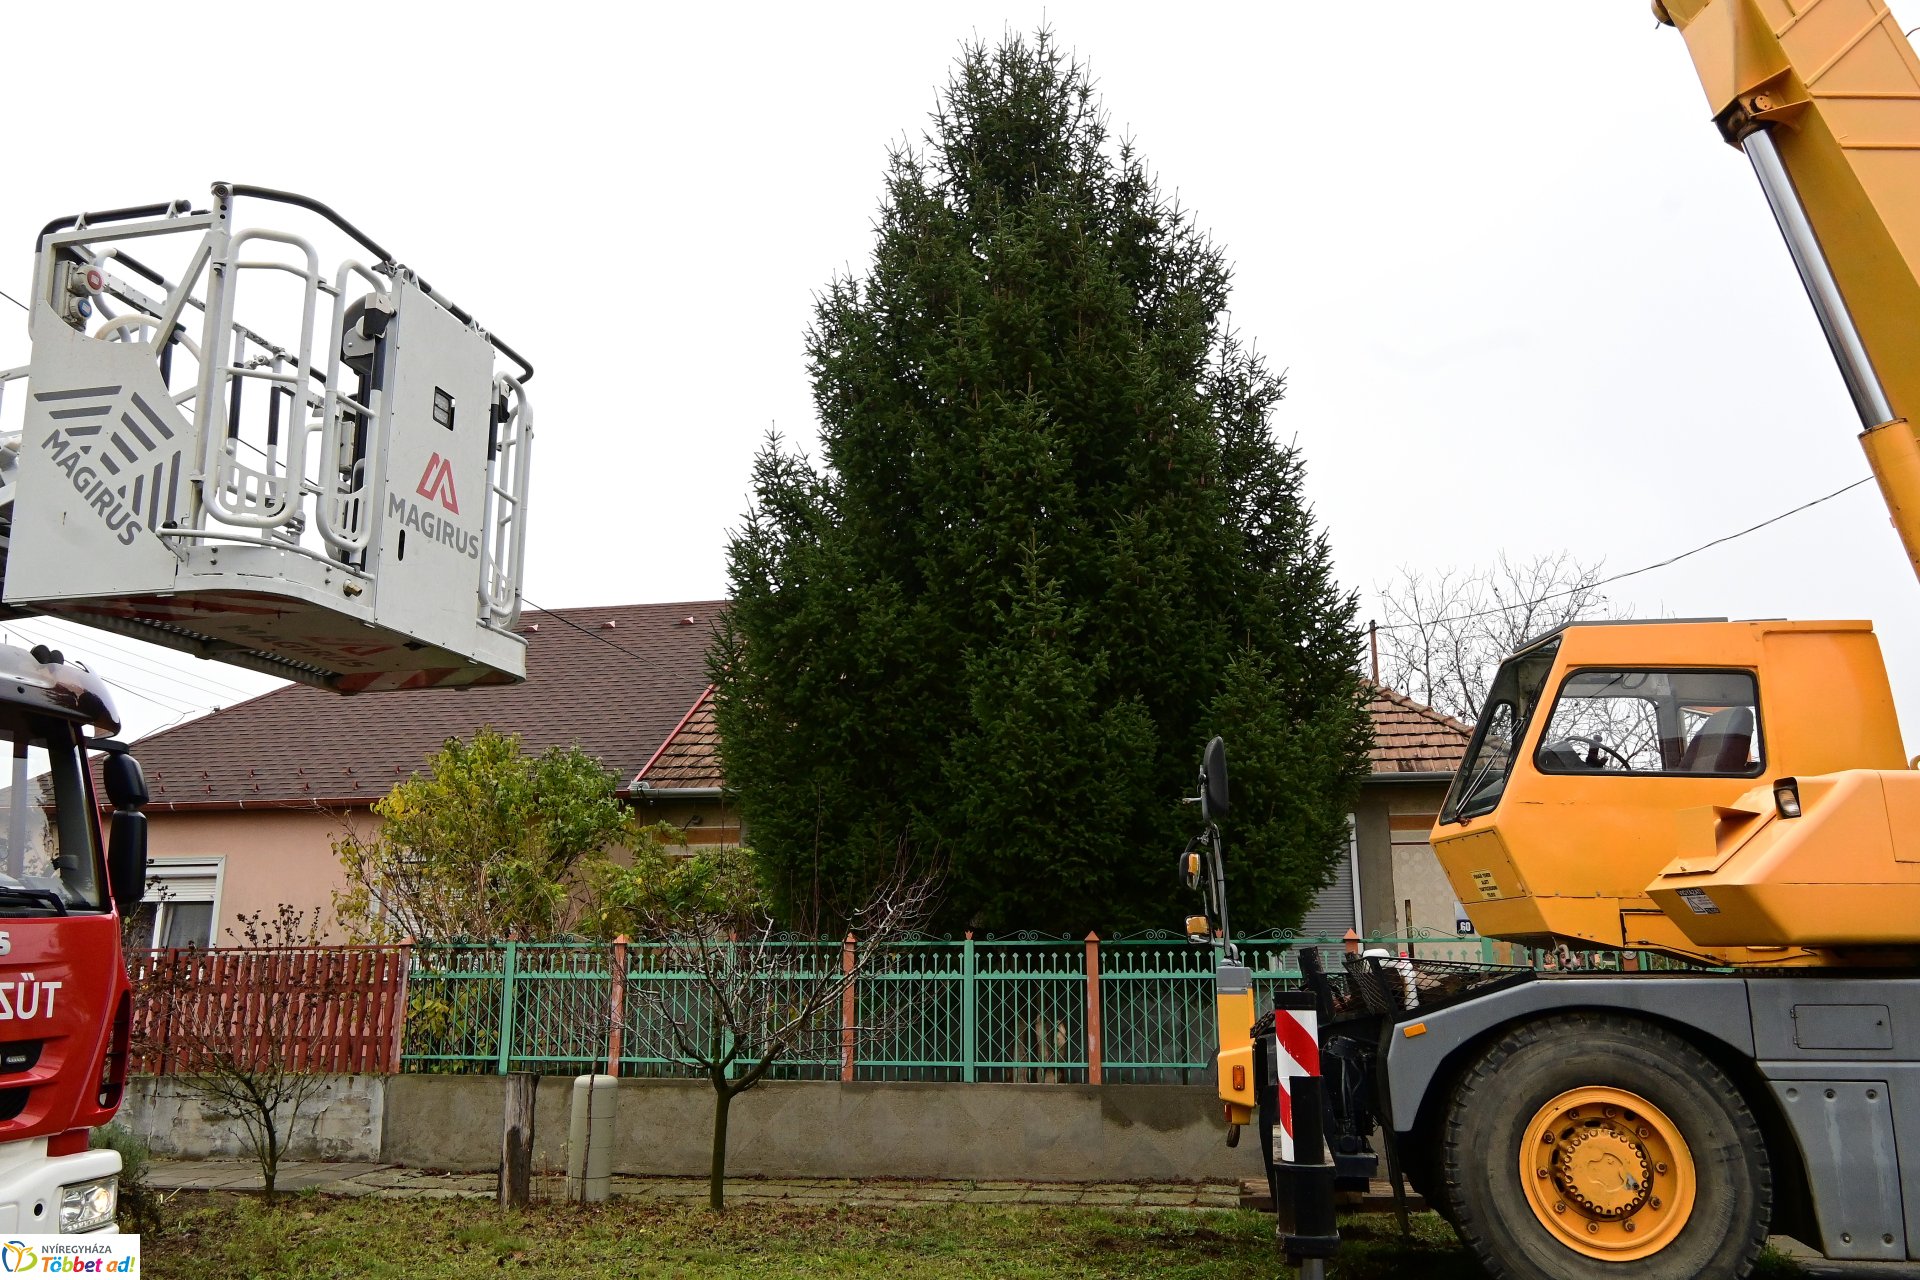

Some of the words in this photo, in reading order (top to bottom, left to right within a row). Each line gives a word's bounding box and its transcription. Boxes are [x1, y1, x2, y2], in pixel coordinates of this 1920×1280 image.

[41, 428, 143, 546] MAGIRUS
[388, 491, 479, 560] MAGIRUS
[1460, 921, 1471, 932] 60
